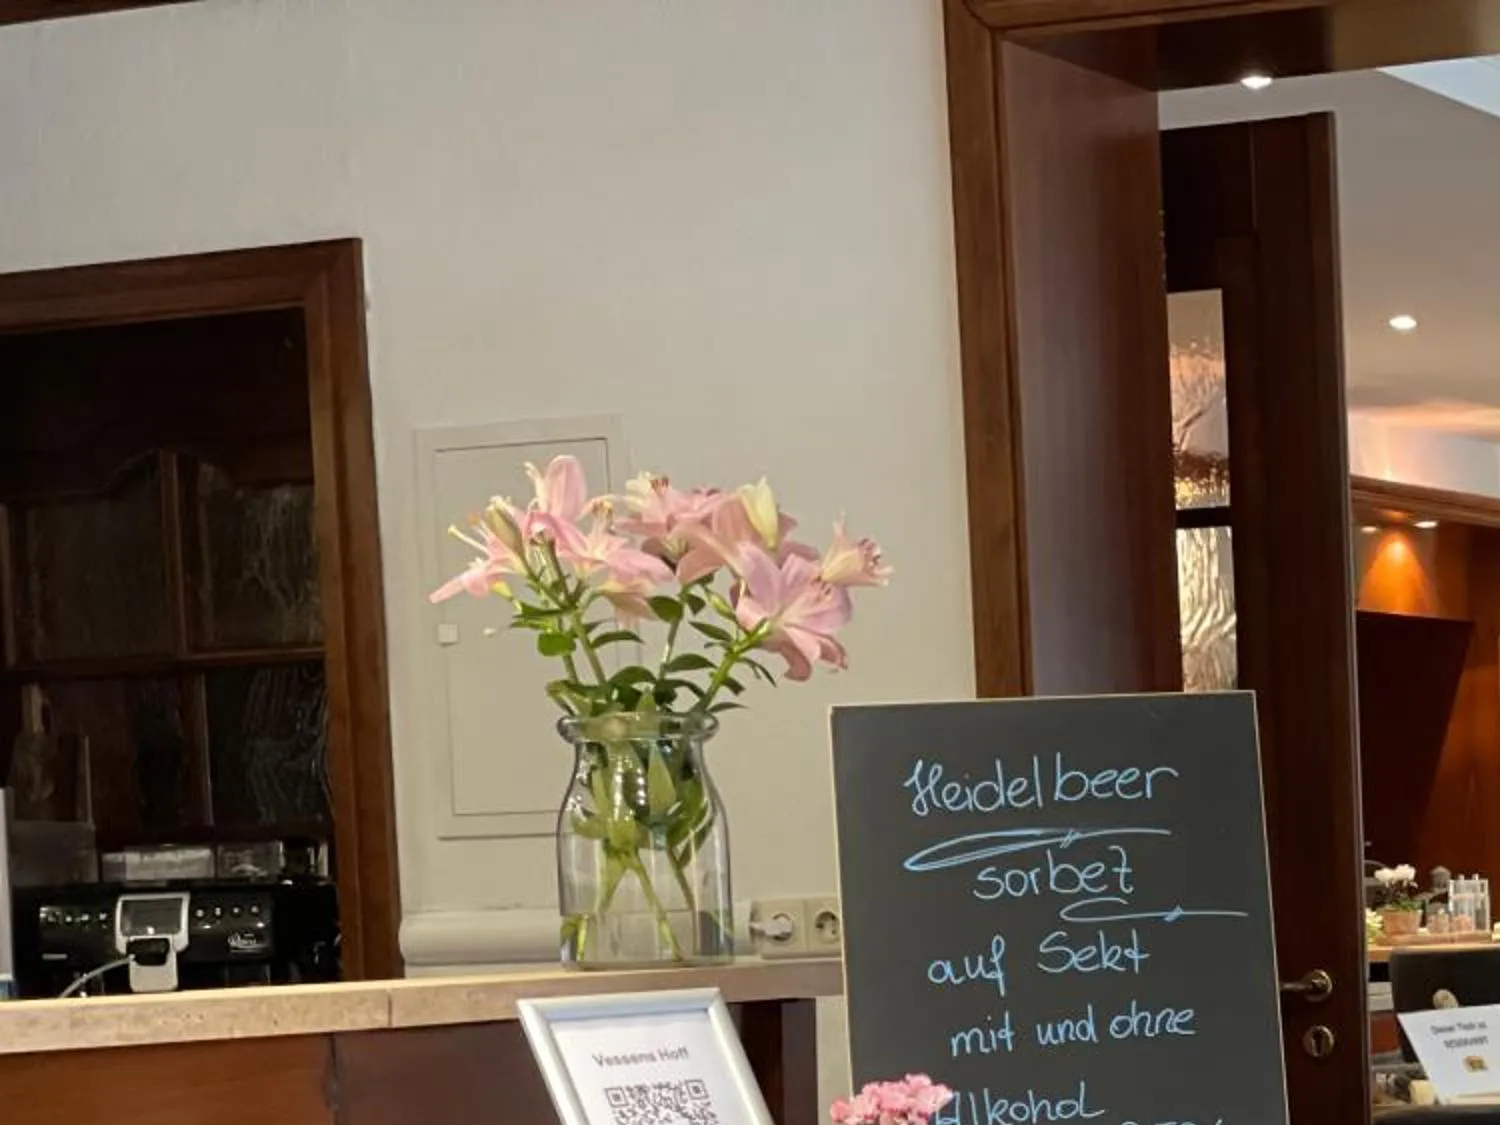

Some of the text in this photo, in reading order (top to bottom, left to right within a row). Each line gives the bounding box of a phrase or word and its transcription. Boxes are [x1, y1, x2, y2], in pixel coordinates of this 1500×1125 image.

[927, 928, 1151, 997] auf Sekt
[592, 1046, 690, 1068] Vessens Hoff
[950, 1000, 1197, 1058] mit und ohne
